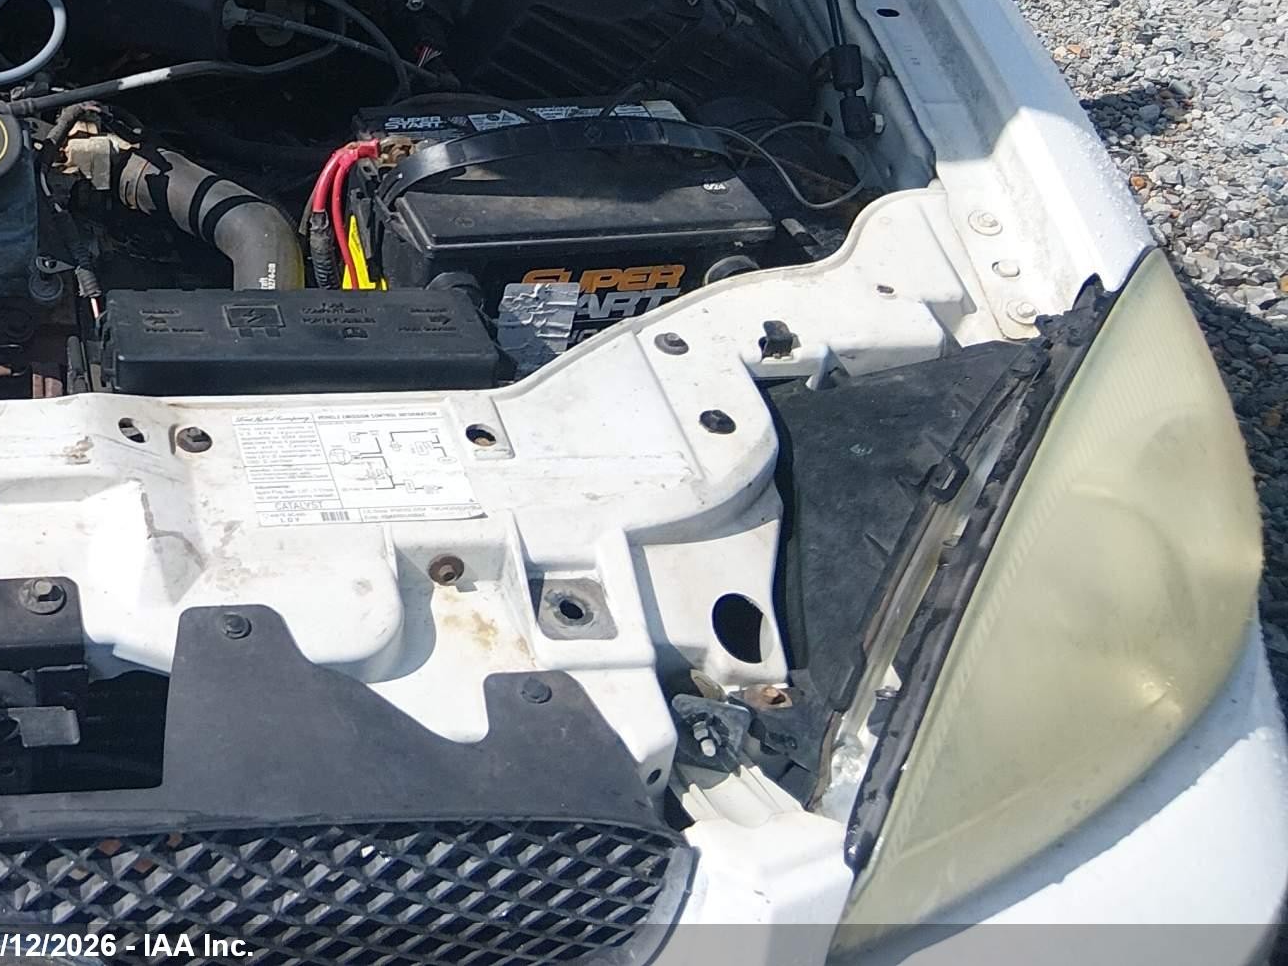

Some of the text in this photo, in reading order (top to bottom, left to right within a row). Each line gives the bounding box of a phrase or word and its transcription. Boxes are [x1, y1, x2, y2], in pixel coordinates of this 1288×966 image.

[388, 115, 441, 123] SUPER
[384, 122, 440, 130] START
[274, 500, 322, 511] CATALYST
